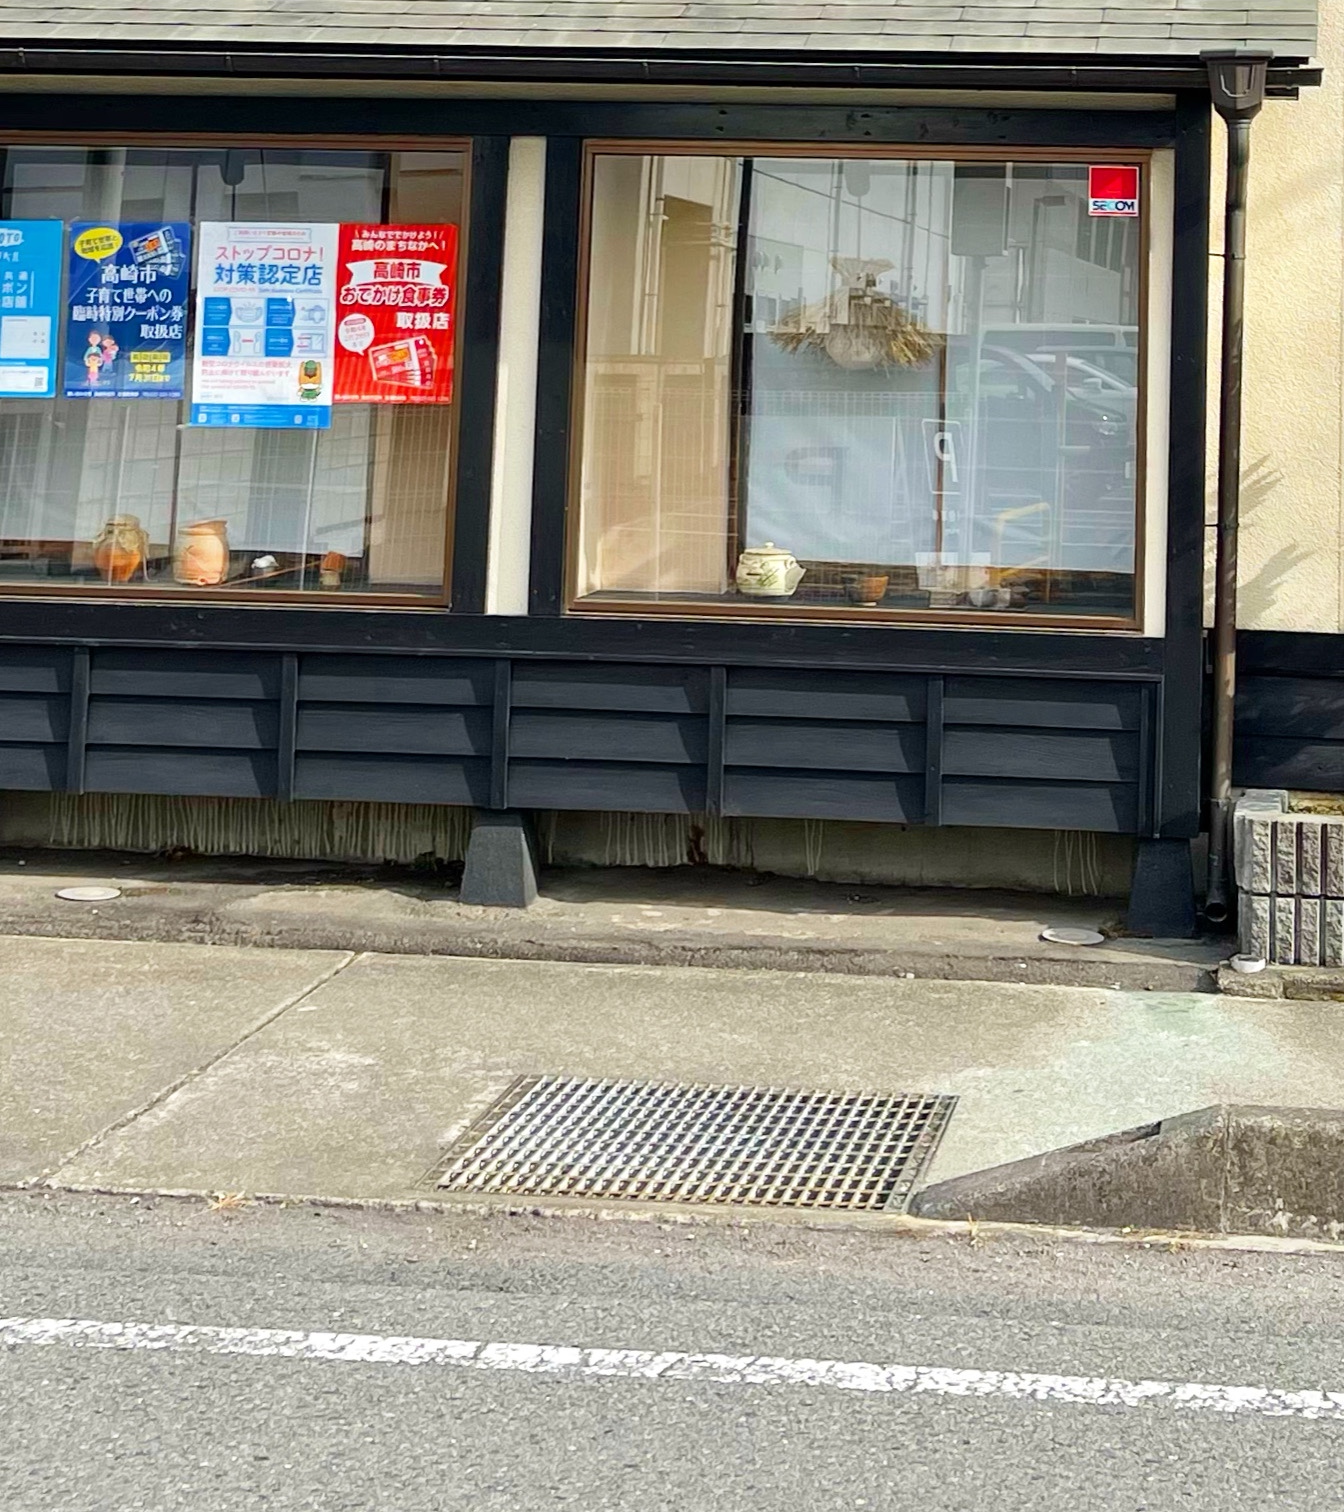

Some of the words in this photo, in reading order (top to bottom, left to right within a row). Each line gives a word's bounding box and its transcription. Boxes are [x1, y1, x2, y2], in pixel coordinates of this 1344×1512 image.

[1092, 200, 1135, 211] SECOM
[101, 264, 157, 284] 高崎市
[214, 263, 325, 286] 対策認定店
[374, 262, 422, 279] 高崎市
[85, 287, 173, 304] 子育て世帯への
[72, 305, 184, 322] 臨時特別クーポン券
[396, 311, 450, 330] 取扱店
[140, 324, 184, 339] 取扱店
